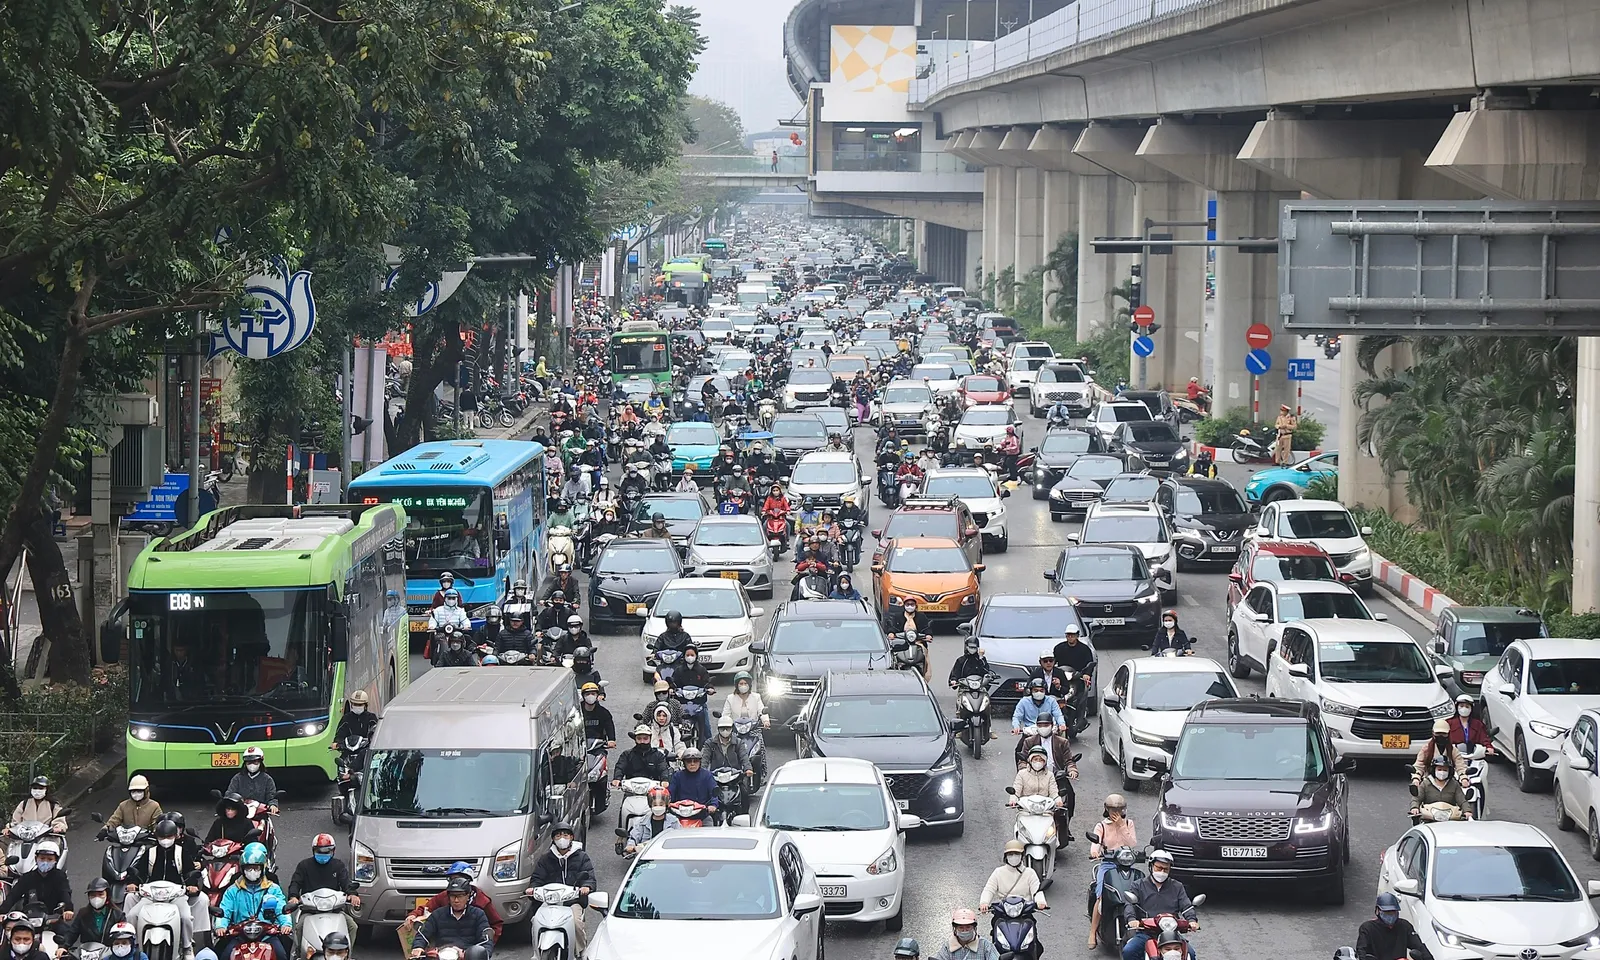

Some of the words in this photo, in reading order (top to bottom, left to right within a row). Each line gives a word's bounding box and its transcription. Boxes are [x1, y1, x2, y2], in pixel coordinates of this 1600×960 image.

[51, 584, 71, 601] 163
[170, 594, 191, 610] E09
[1222, 848, 1266, 856] 51G-771.52
